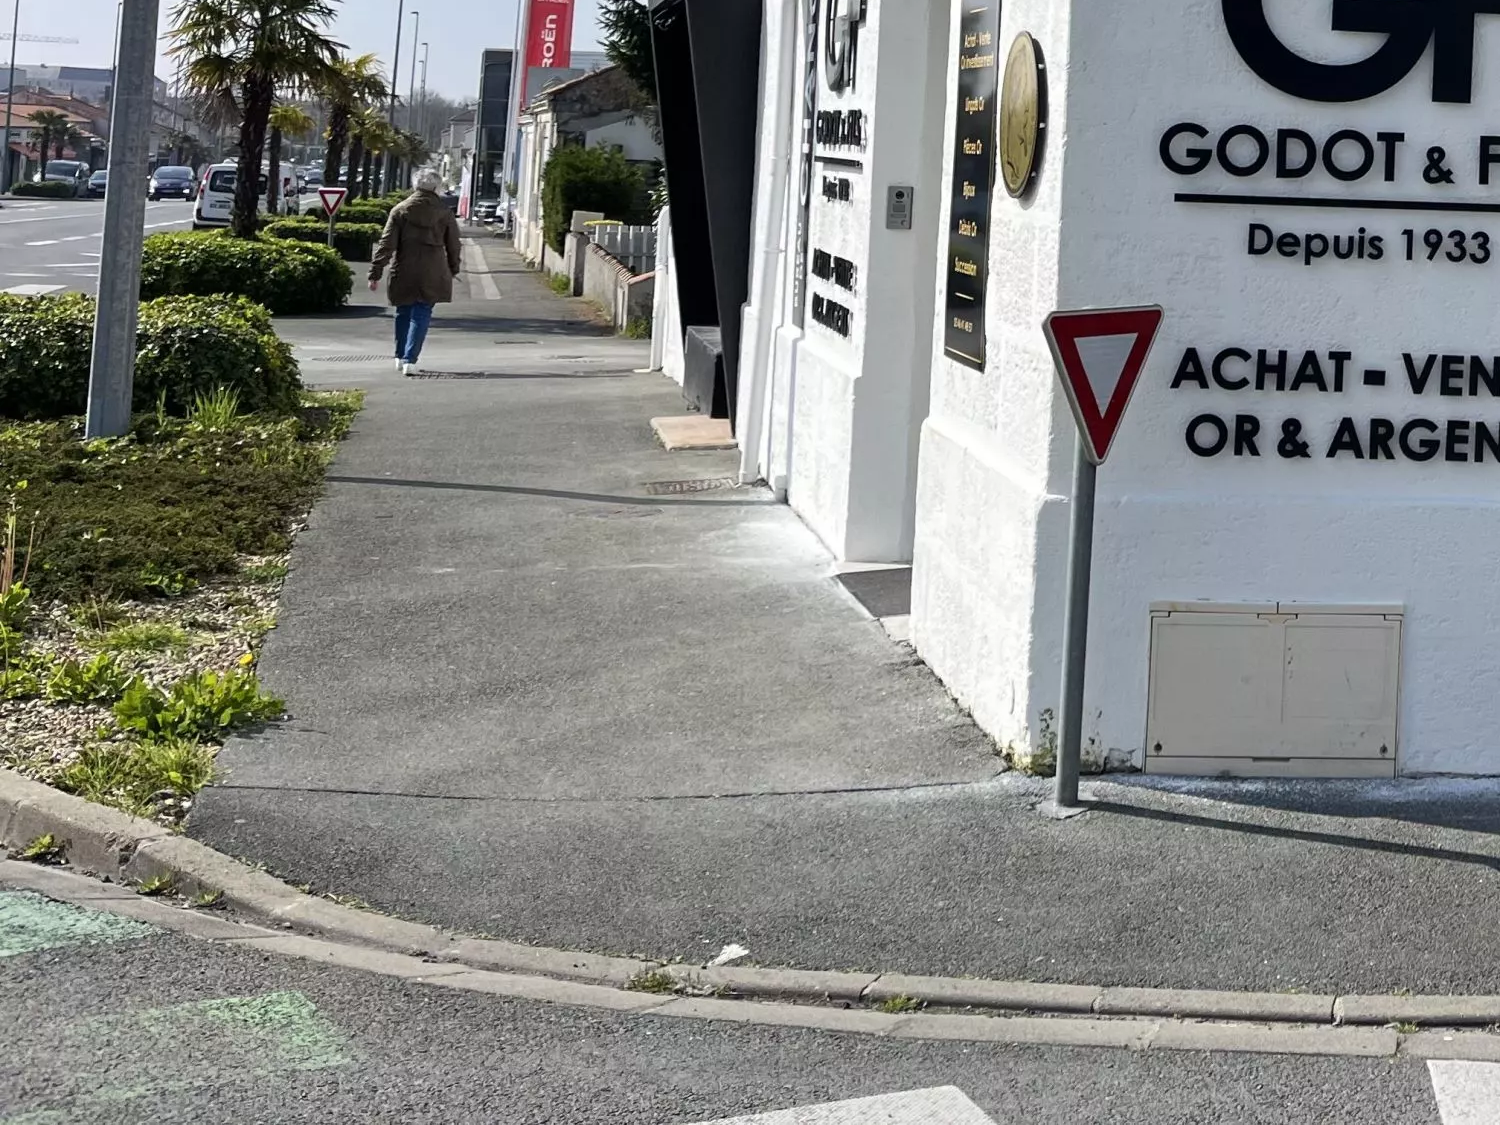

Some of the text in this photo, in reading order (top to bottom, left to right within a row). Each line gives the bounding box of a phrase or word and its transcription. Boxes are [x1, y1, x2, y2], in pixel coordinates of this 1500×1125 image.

[1159, 122, 1405, 183] GODOT
[1422, 146, 1456, 184] &
[1247, 223, 1491, 265] Depuis 1933
[1170, 347, 1351, 393] ACHAT
[1363, 370, 1386, 386] -
[1185, 413, 1260, 458] OR
[1277, 418, 1311, 458] &
